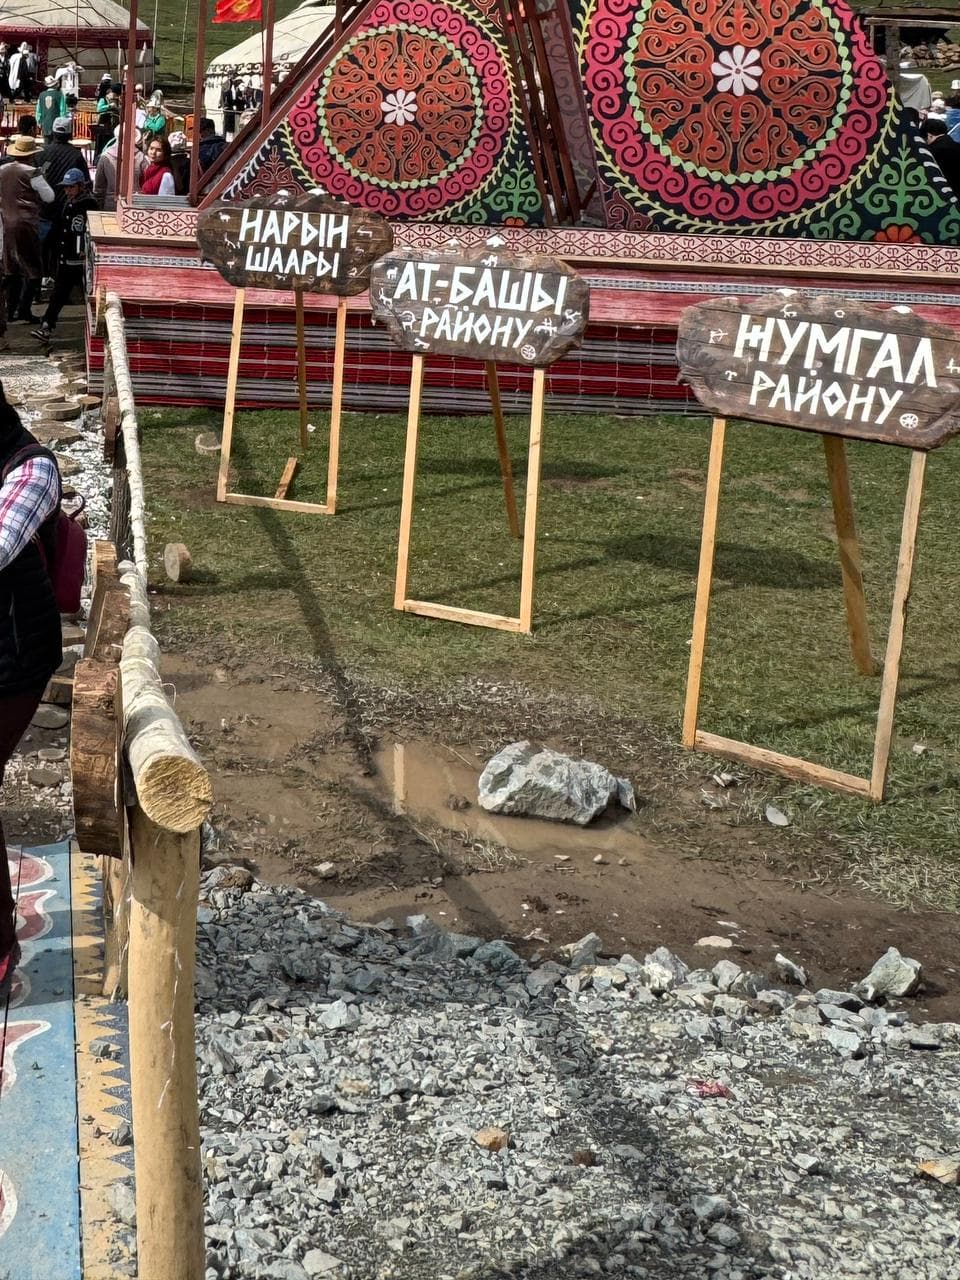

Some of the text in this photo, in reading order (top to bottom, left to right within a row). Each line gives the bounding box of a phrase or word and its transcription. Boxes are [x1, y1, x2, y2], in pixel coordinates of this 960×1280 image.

[239, 207, 349, 249] НАРЫН
[245, 245, 341, 278] ШААРЫ
[393, 262, 568, 316] АТ-БАШЫ
[419, 305, 534, 348] РАЙОНУ
[749, 369, 904, 425] РАЙОНУ
